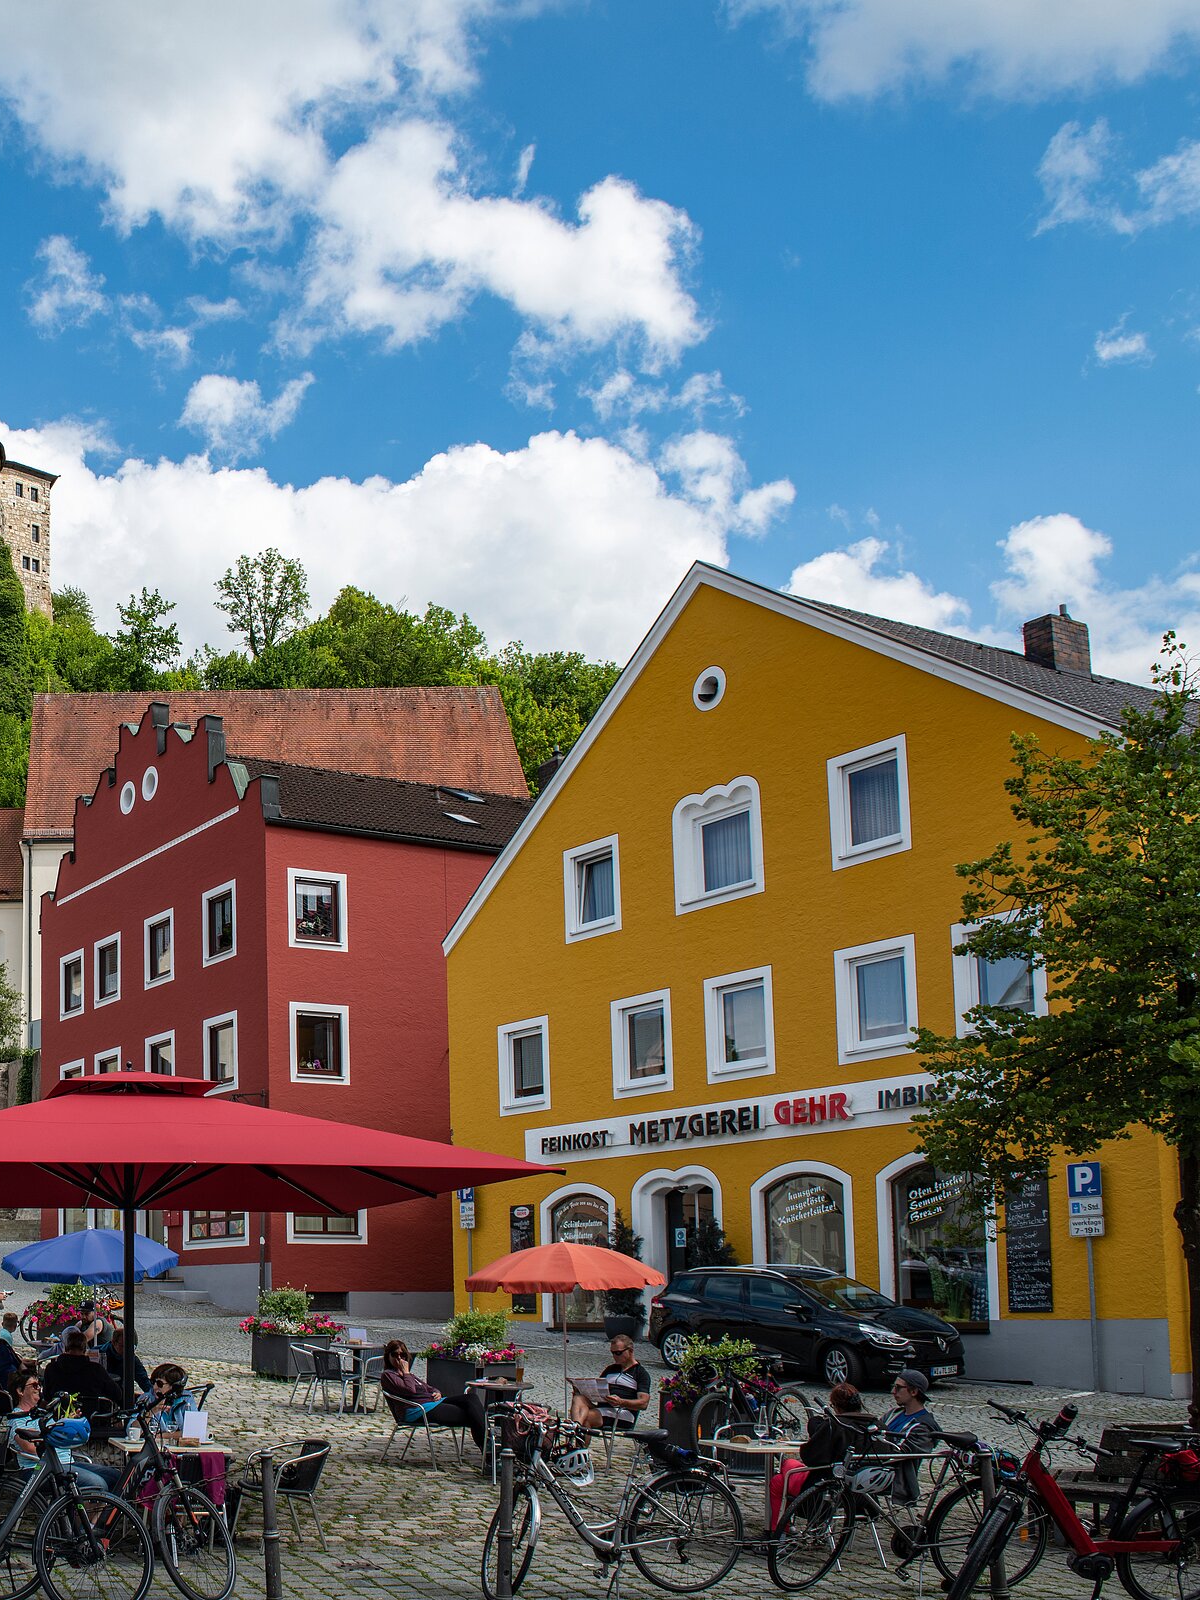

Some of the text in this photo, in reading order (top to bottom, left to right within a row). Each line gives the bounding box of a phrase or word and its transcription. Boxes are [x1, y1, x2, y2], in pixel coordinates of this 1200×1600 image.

[541, 1082, 949, 1155] FEINKOST METZGEREI GEHR IMBISS
[1074, 1167, 1093, 1192] P
[787, 1185, 825, 1201] hausgem.
[909, 1189, 952, 1210] Semmeln
[785, 1194, 826, 1213] ausgelöste
[1072, 1218, 1101, 1227] werktags
